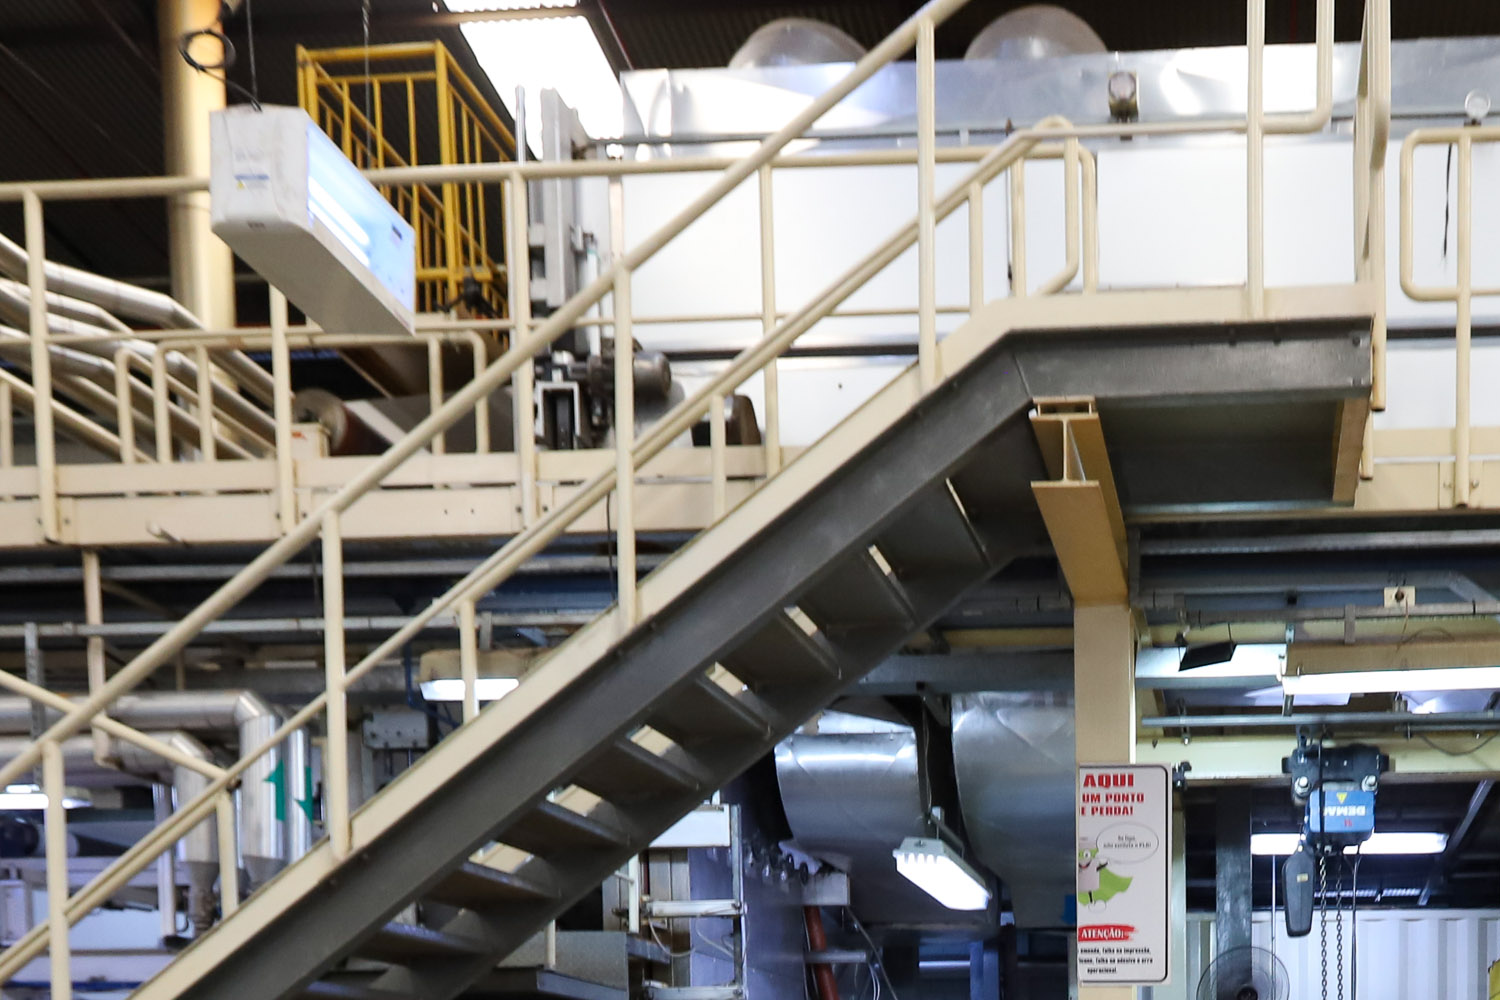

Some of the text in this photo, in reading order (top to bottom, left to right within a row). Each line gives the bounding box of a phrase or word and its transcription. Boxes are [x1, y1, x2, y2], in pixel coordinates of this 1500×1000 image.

[1084, 774, 1133, 788] AQUI
[1082, 793, 1144, 803] UM PONTO
[1091, 806, 1133, 816] PERDA!
[1081, 928, 1124, 940] ATENÇÃO!
